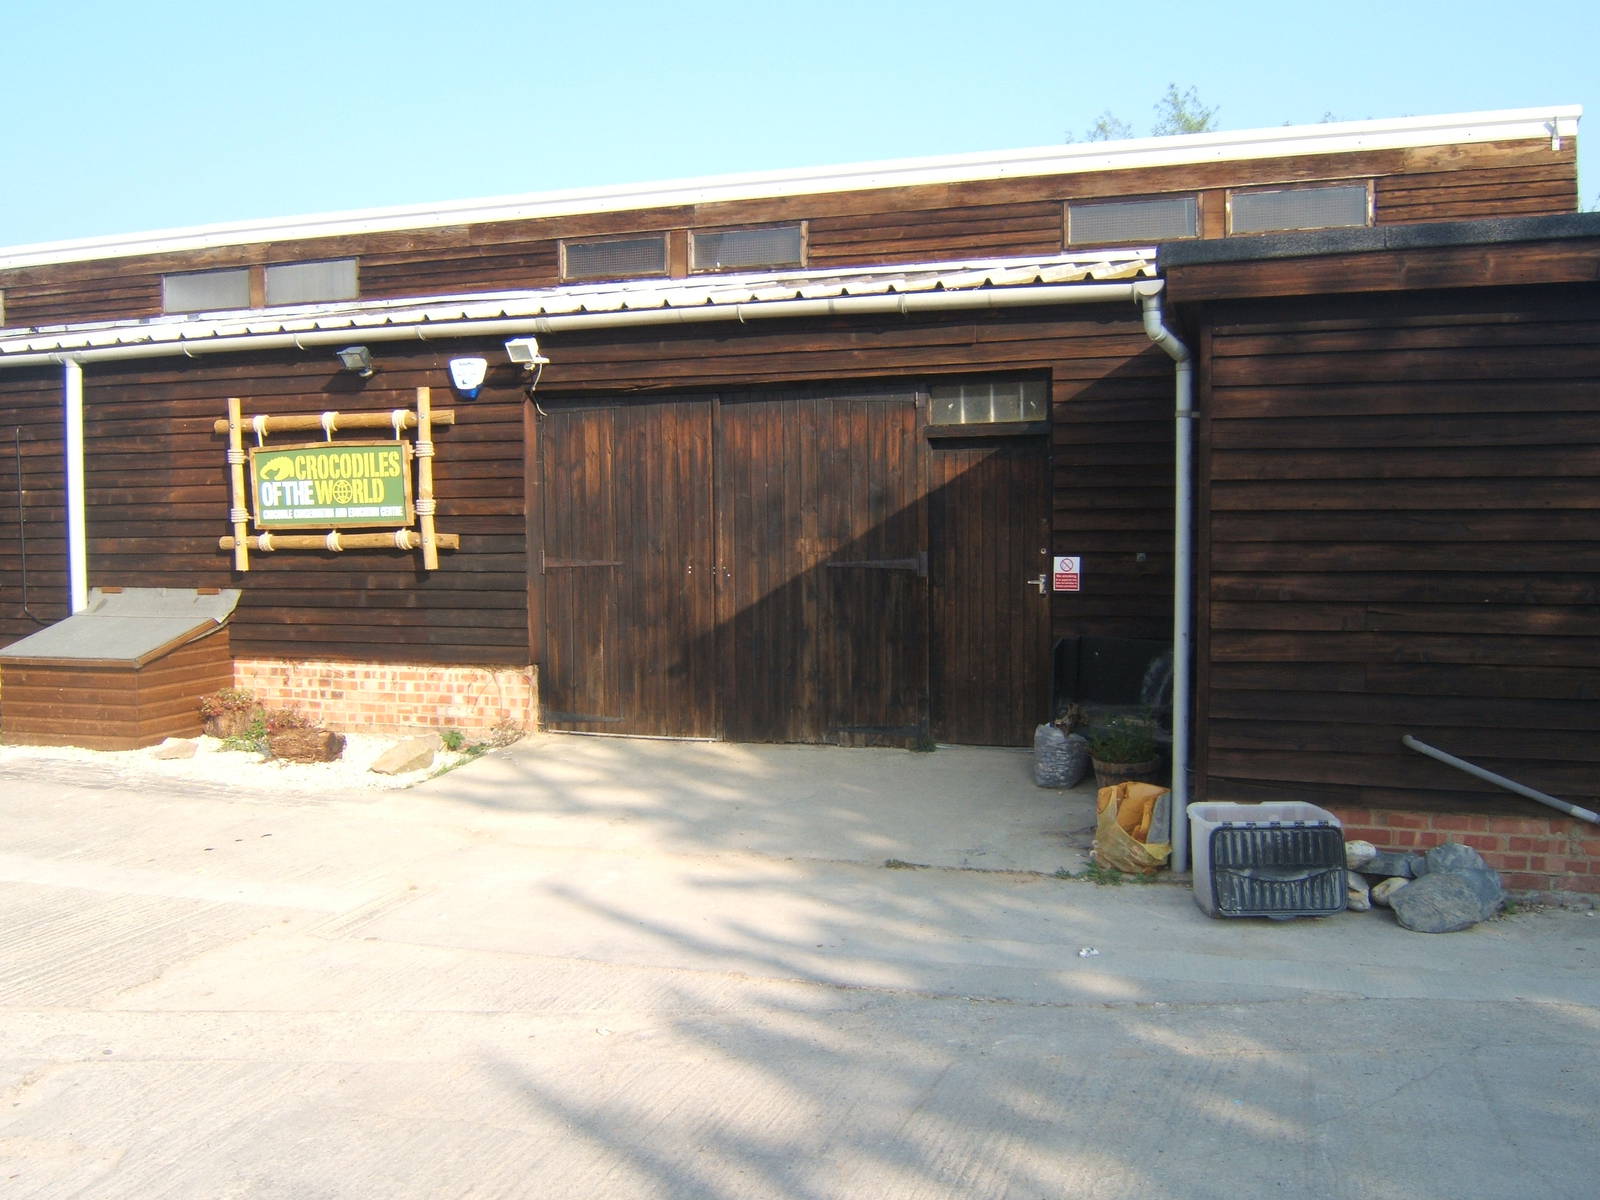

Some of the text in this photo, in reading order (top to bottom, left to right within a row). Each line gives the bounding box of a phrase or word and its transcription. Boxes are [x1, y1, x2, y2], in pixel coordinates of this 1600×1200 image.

[294, 451, 401, 480] CROCODILES
[261, 478, 385, 506] OF THE WORLD
